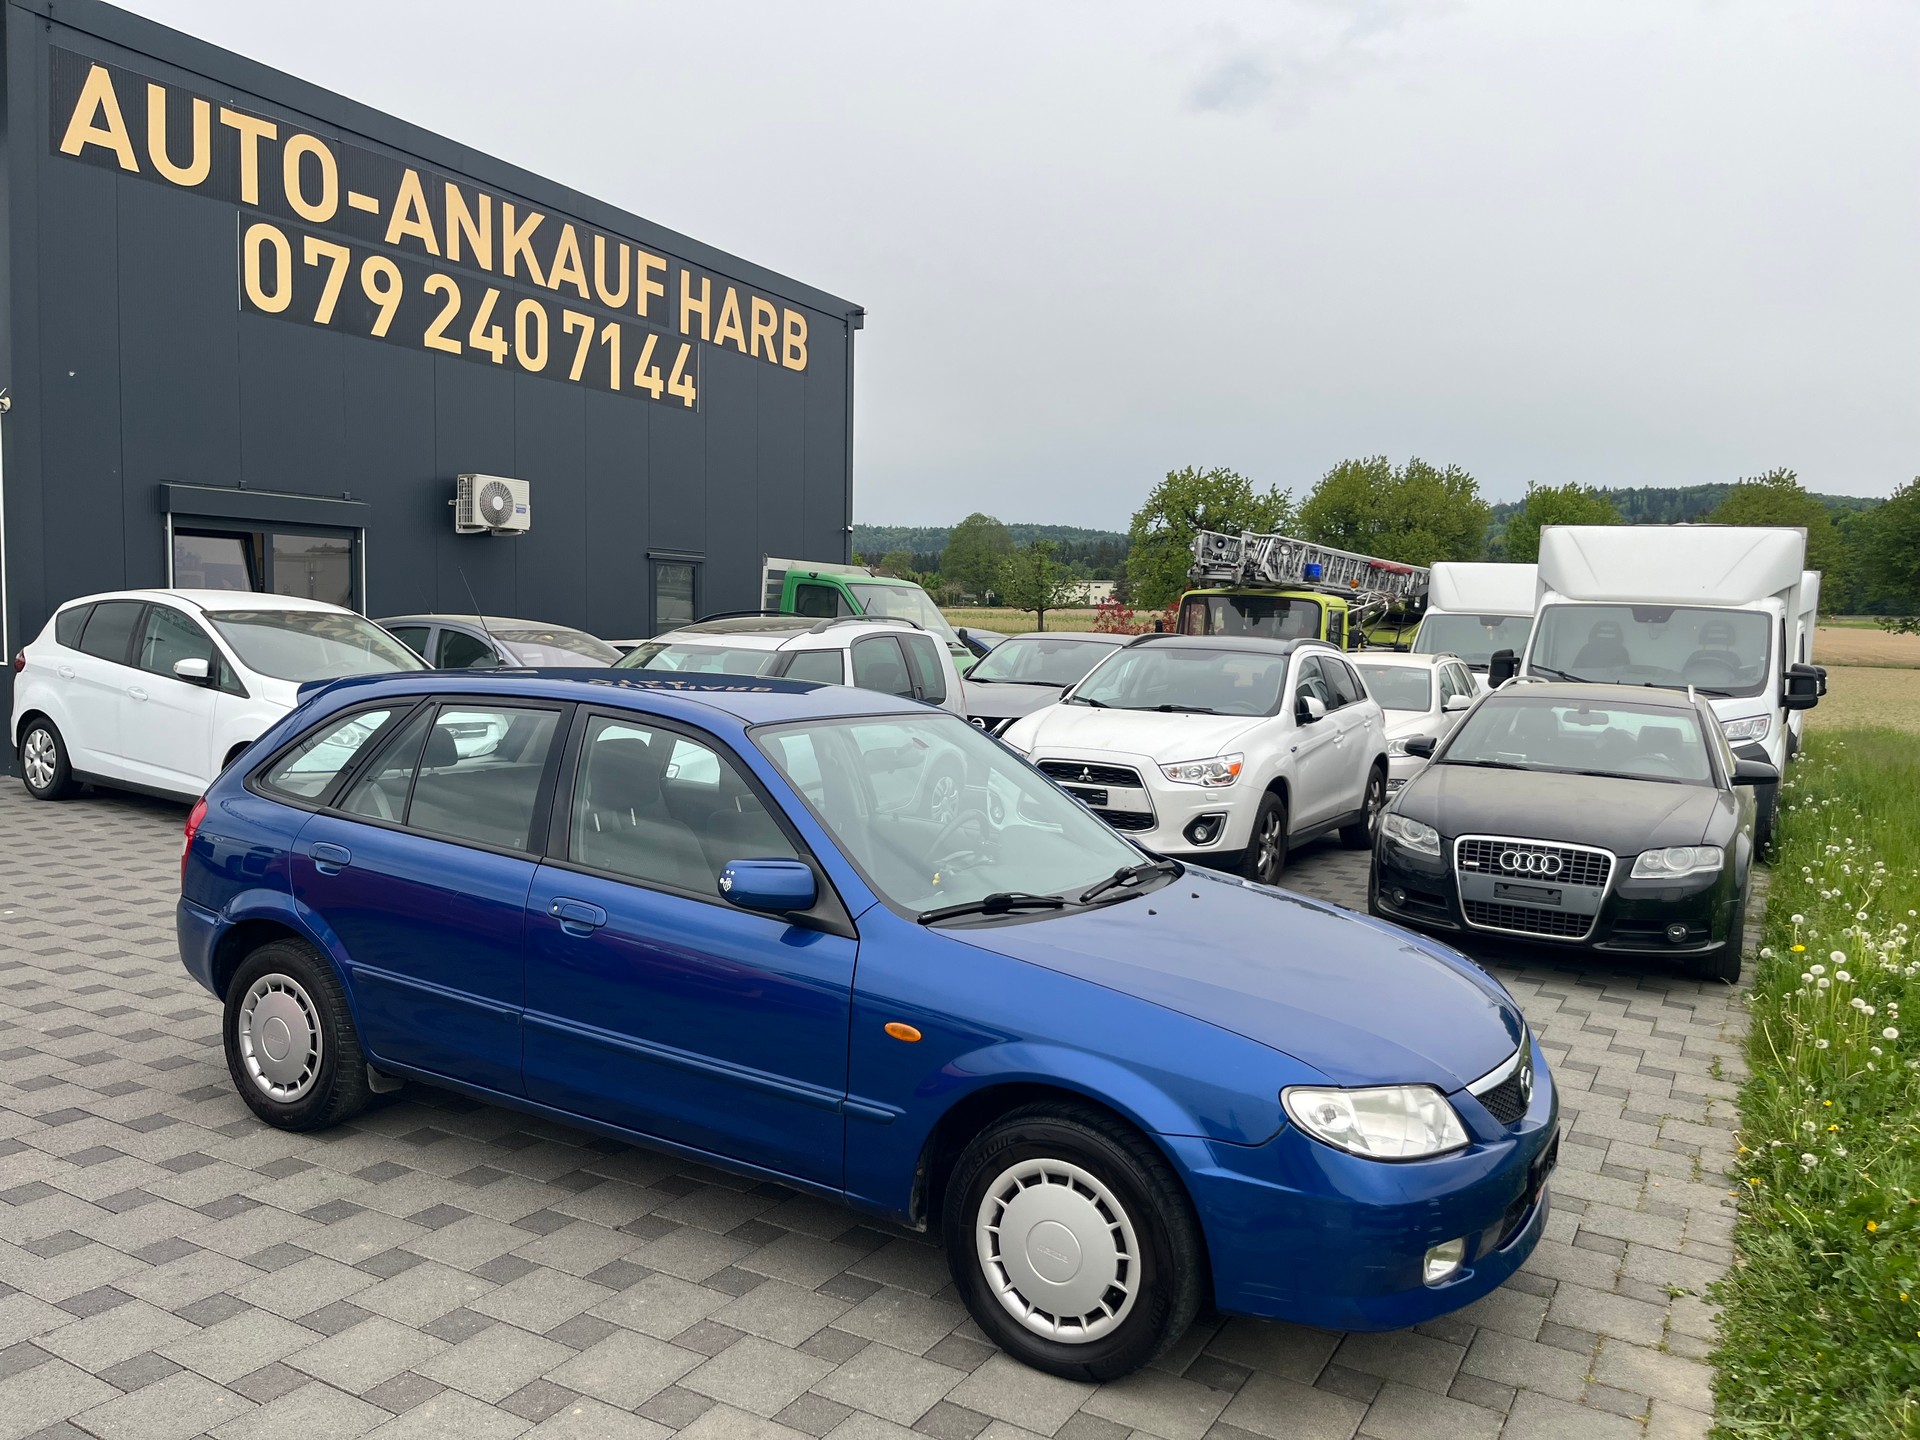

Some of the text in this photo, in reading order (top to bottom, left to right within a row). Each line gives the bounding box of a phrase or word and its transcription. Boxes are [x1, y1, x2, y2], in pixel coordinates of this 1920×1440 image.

[60, 65, 809, 372] AUTO-ANKAUF HARB
[244, 222, 404, 338] 079
[423, 272, 549, 373] 240
